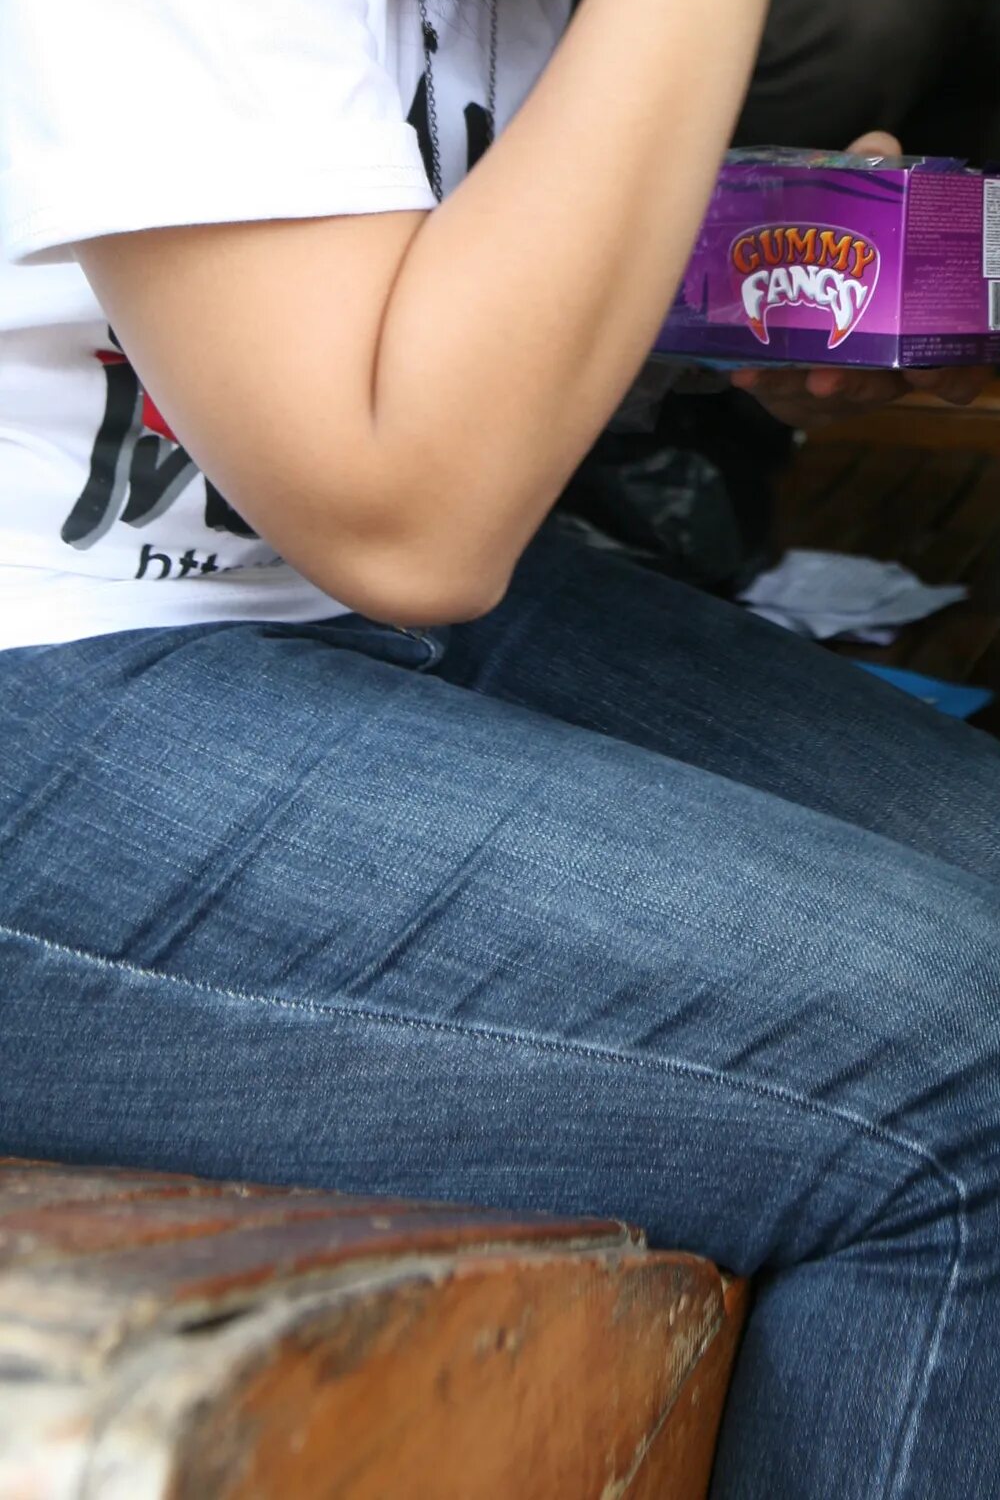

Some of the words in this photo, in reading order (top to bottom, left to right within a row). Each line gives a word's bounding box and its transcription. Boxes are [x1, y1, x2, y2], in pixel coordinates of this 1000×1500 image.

[732, 227, 875, 278] GUMMY
[739, 264, 869, 343] FANGS
[134, 543, 243, 581] htt
